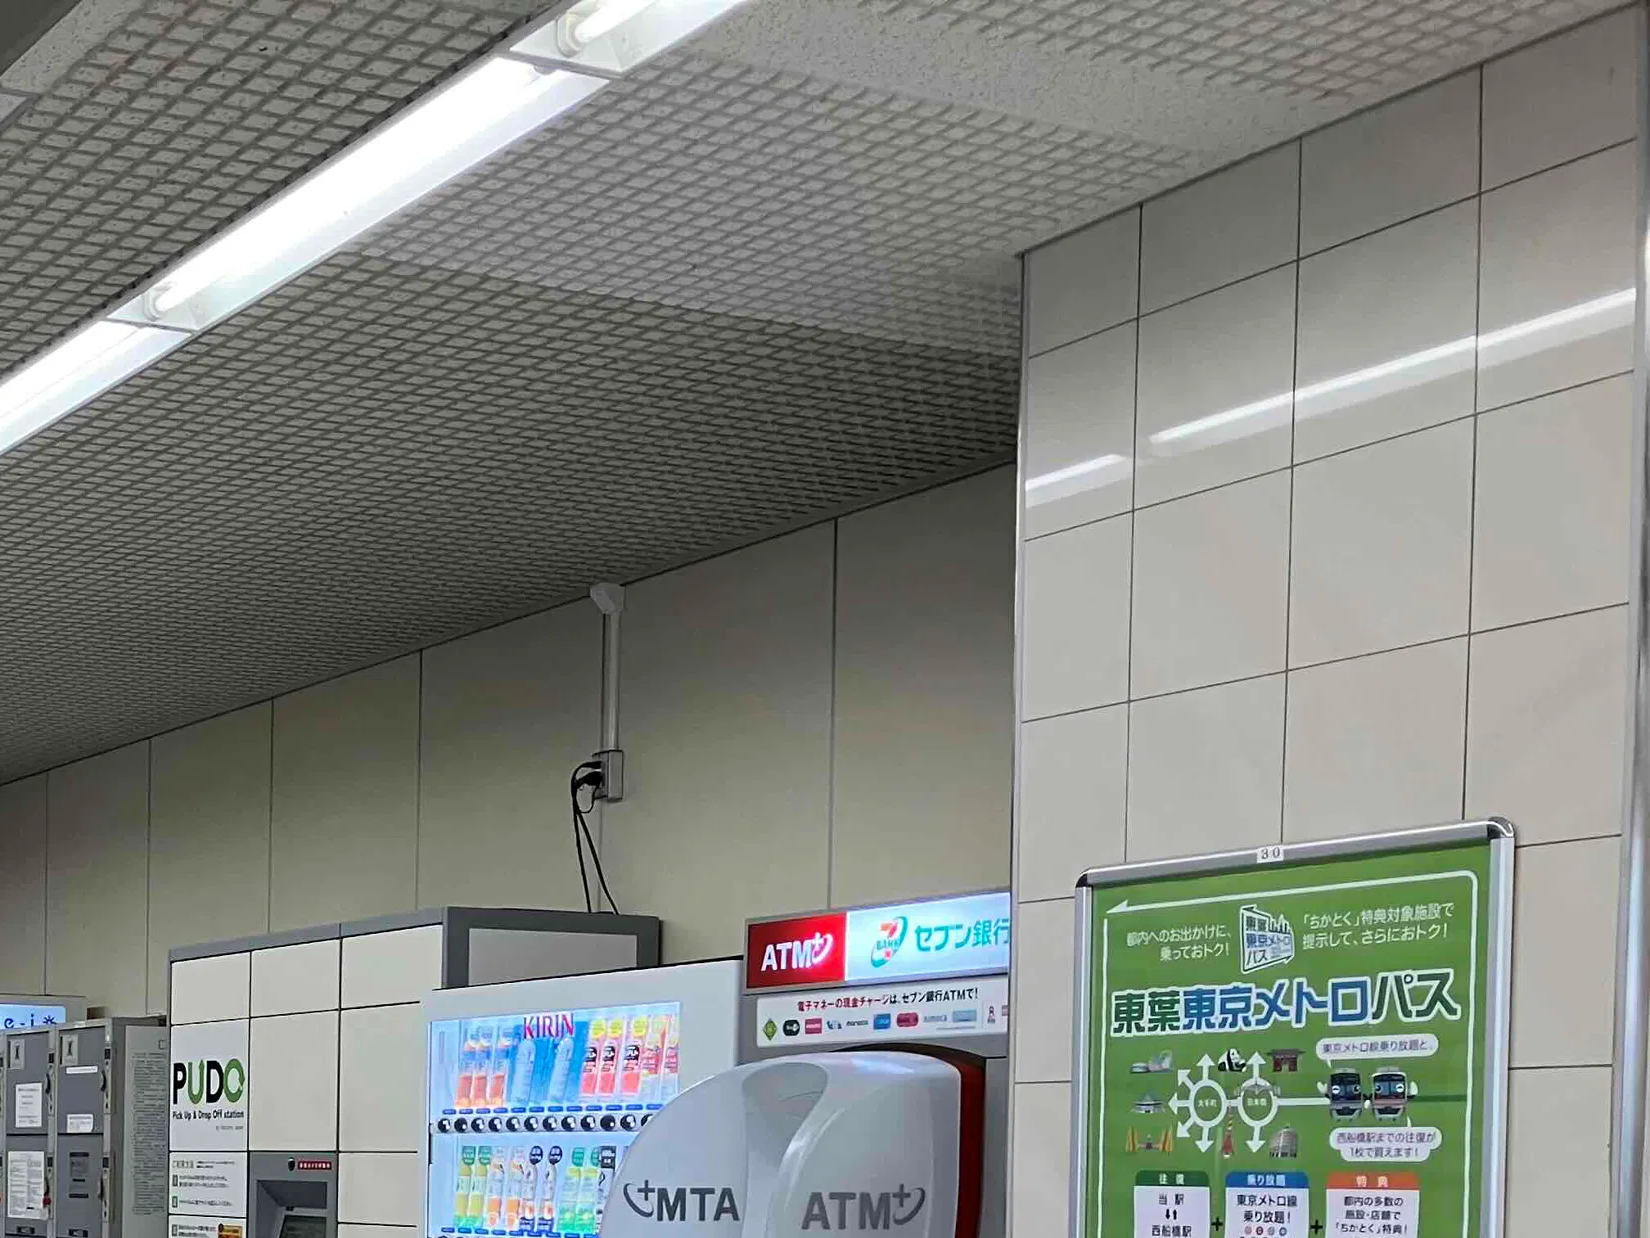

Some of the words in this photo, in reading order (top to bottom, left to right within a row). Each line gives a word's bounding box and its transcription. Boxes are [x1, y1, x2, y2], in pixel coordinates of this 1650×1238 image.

[1261, 846, 1280, 860] 30
[761, 939, 812, 972] ATM
[1112, 971, 1459, 1034] 東葉東京メトロパス
[523, 1012, 575, 1040] KIRIN
[173, 1058, 246, 1105] PUDO
[801, 1191, 891, 1231] ATM
[1152, 1225, 1192, 1238] 西船橋駅
